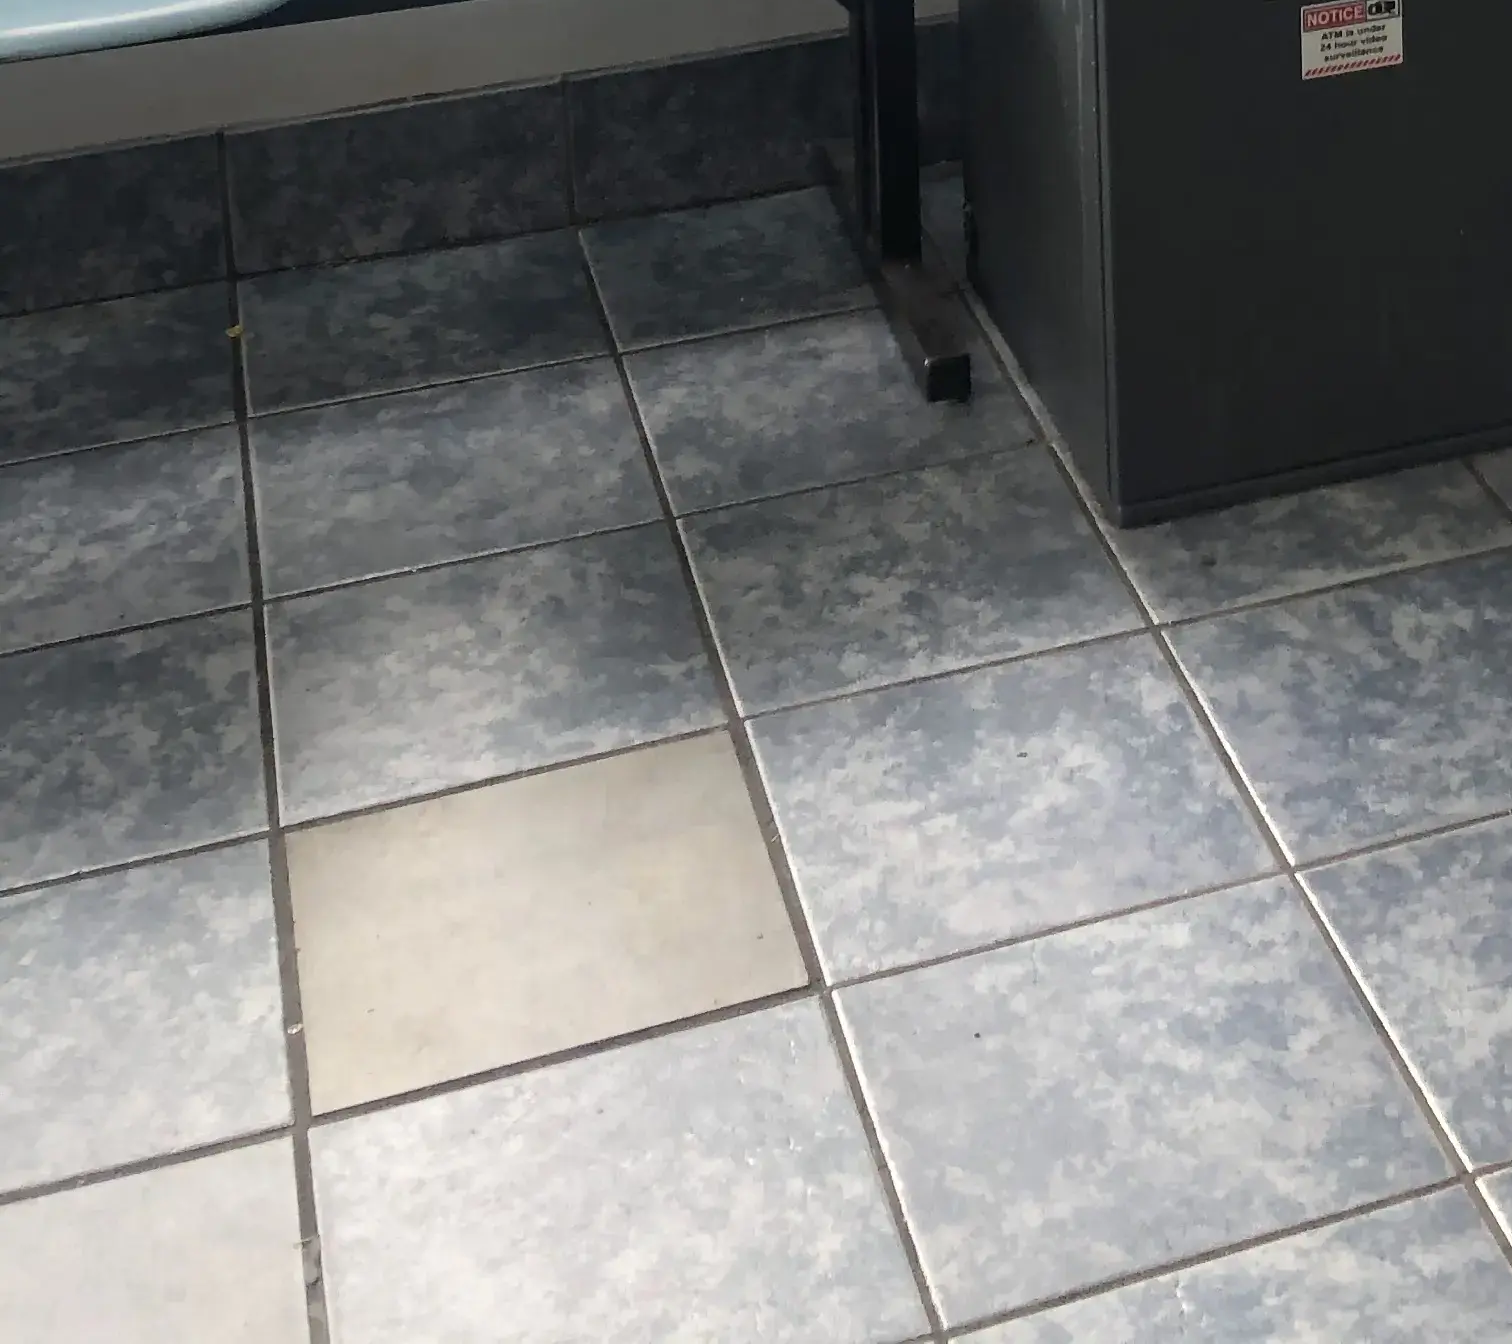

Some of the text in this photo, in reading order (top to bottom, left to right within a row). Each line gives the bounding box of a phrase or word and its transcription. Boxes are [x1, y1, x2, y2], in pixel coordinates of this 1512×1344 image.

[1307, 3, 1364, 27] NOTICE
[1321, 30, 1343, 41] ATM
[1320, 43, 1332, 52] 24
